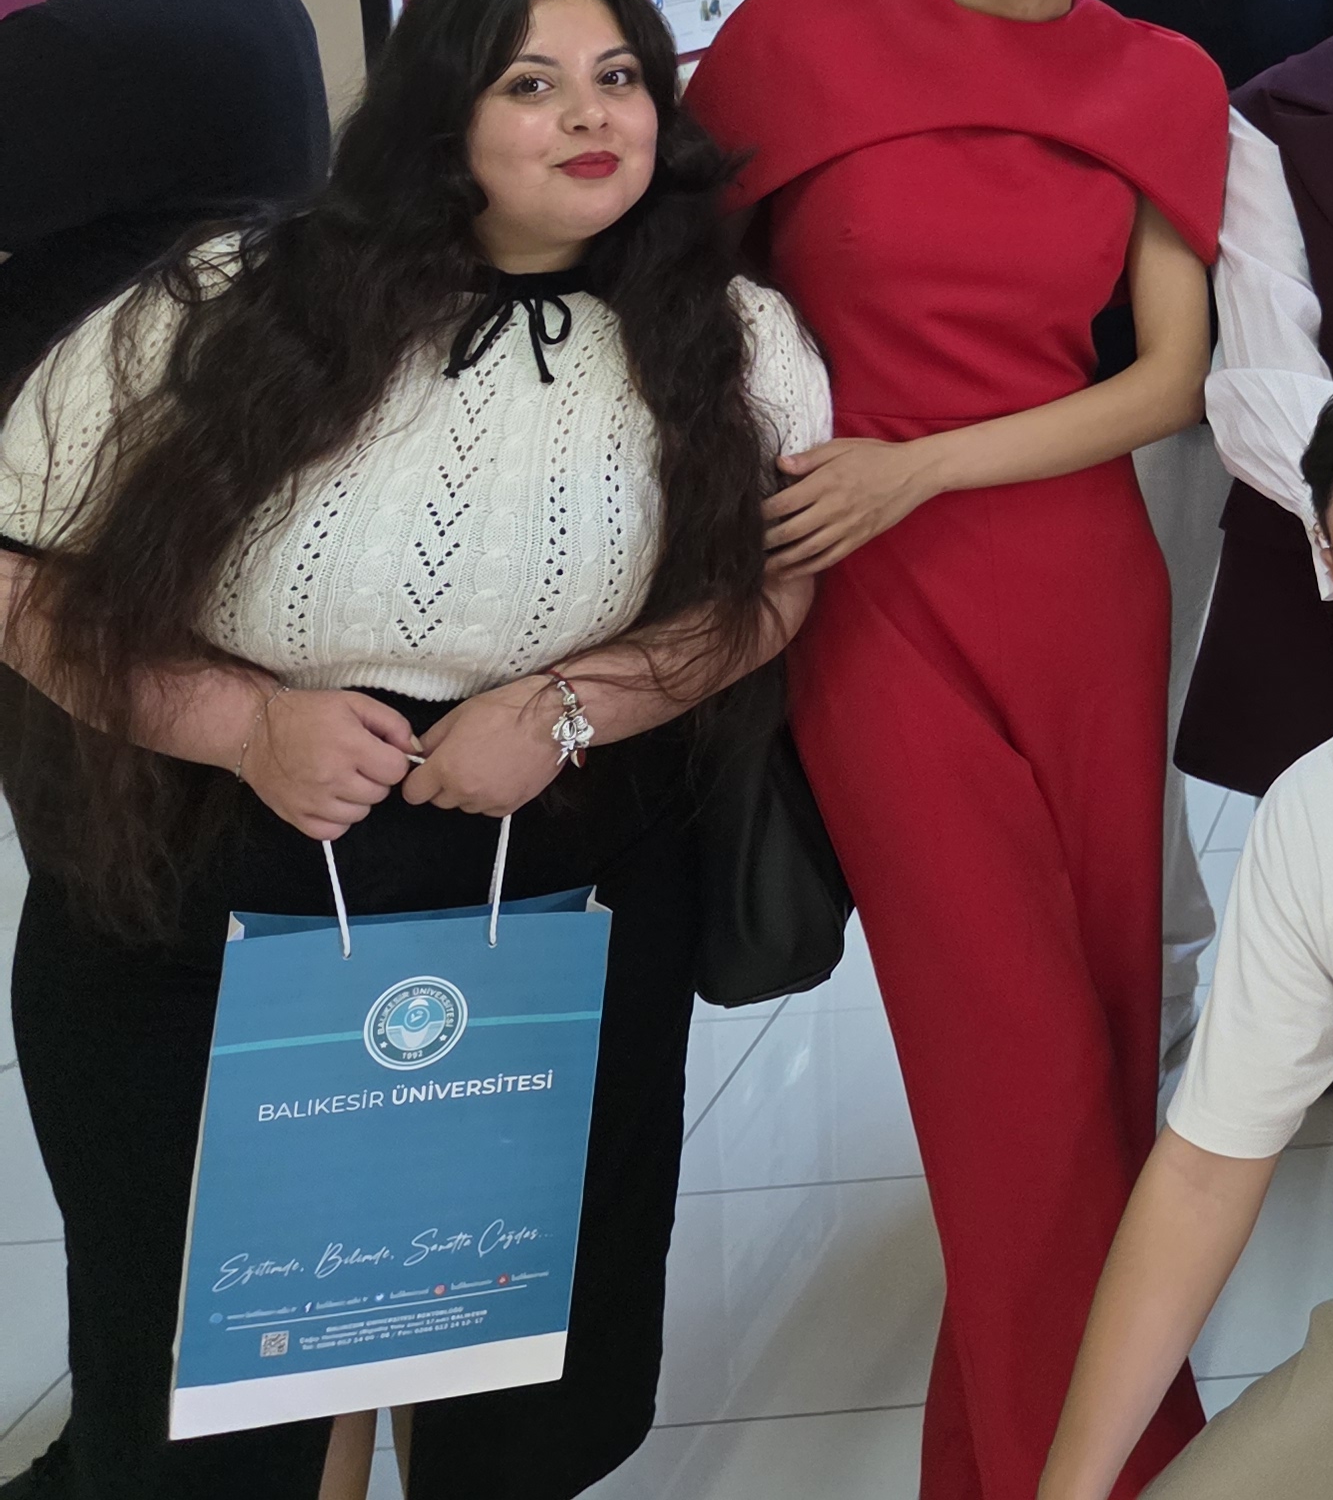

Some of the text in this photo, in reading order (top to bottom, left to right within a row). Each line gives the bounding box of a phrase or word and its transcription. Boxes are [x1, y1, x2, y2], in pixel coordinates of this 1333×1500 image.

[377, 987, 455, 1035] BALIKESİR ÜNİVERSİTESİ
[402, 1050, 424, 1059] 1992
[257, 1069, 554, 1122] BALIKESİR ÜNİVERSİTESİ
